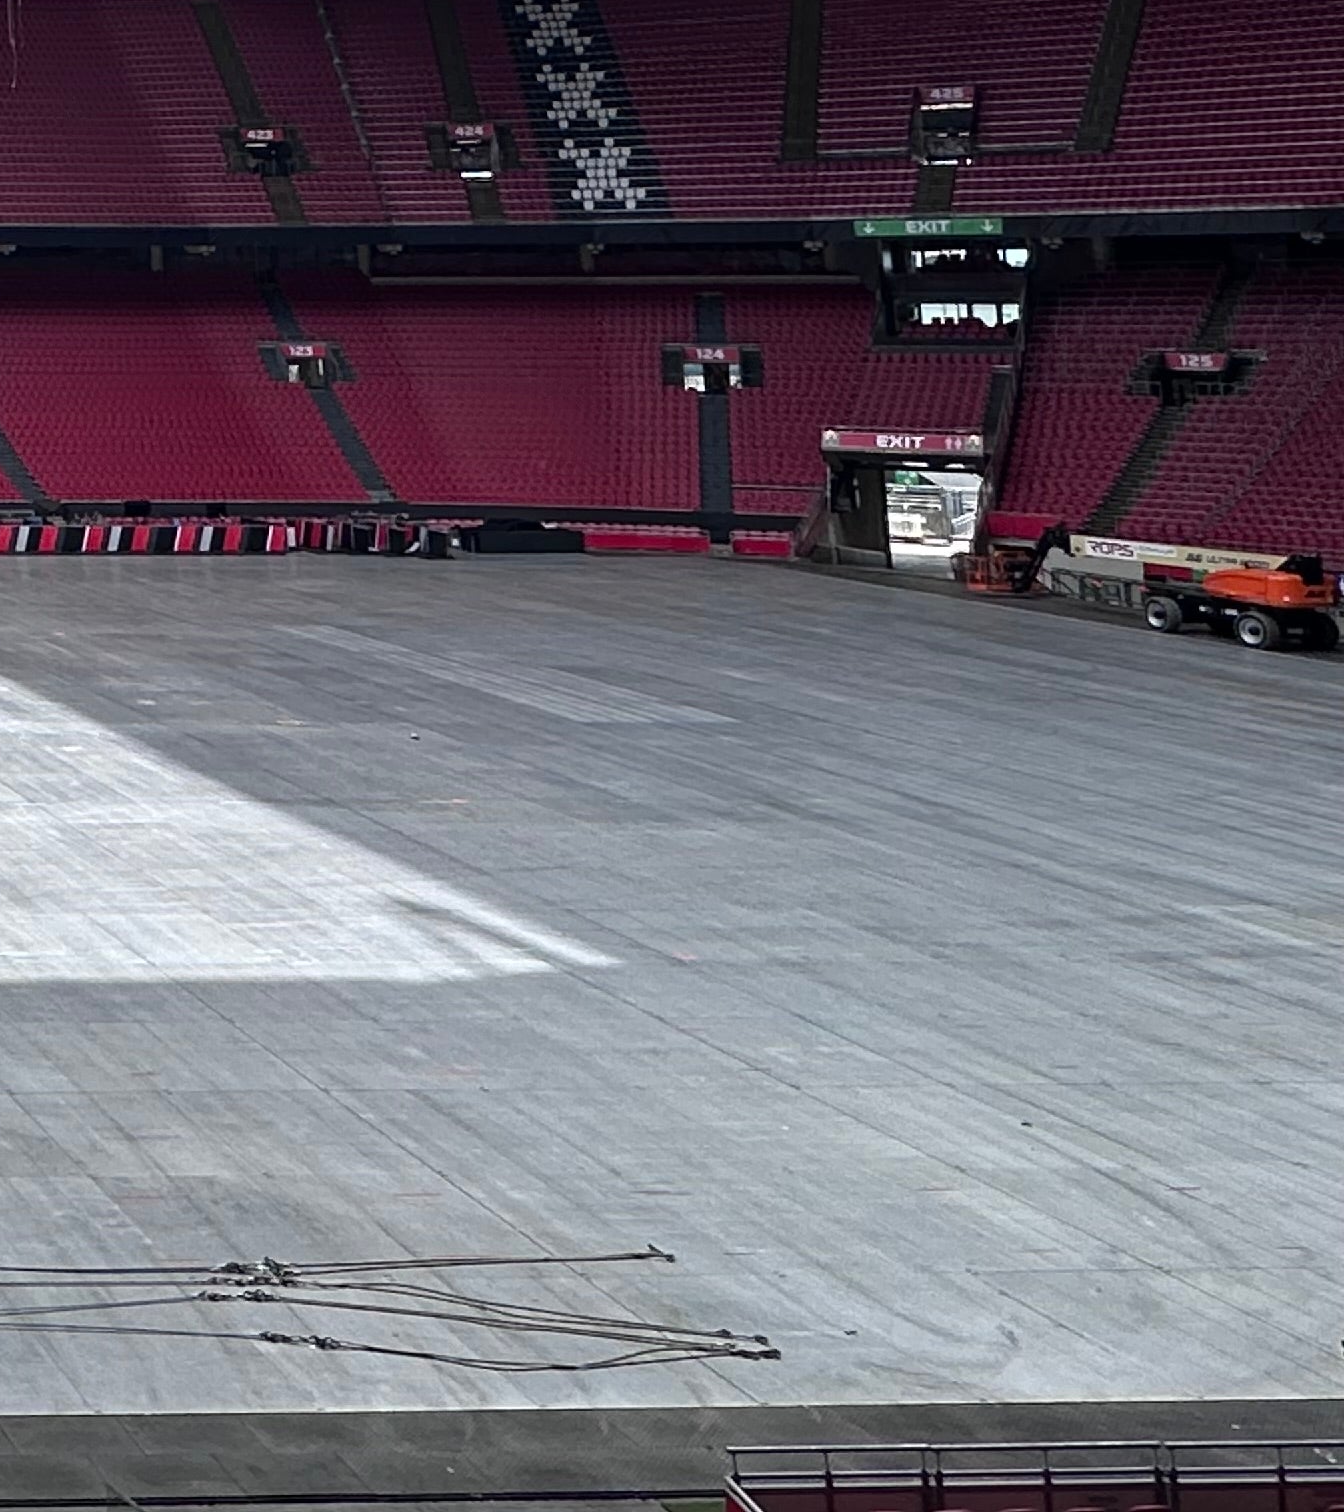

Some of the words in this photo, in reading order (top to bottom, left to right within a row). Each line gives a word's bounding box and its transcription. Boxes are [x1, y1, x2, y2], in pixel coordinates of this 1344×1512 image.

[930, 88, 963, 99] 425
[454, 126, 484, 138] 424
[904, 219, 951, 234] EXIT
[288, 345, 313, 356] 123
[696, 348, 725, 359] 124
[1179, 354, 1213, 367] 125
[876, 434, 926, 448] EXIT
